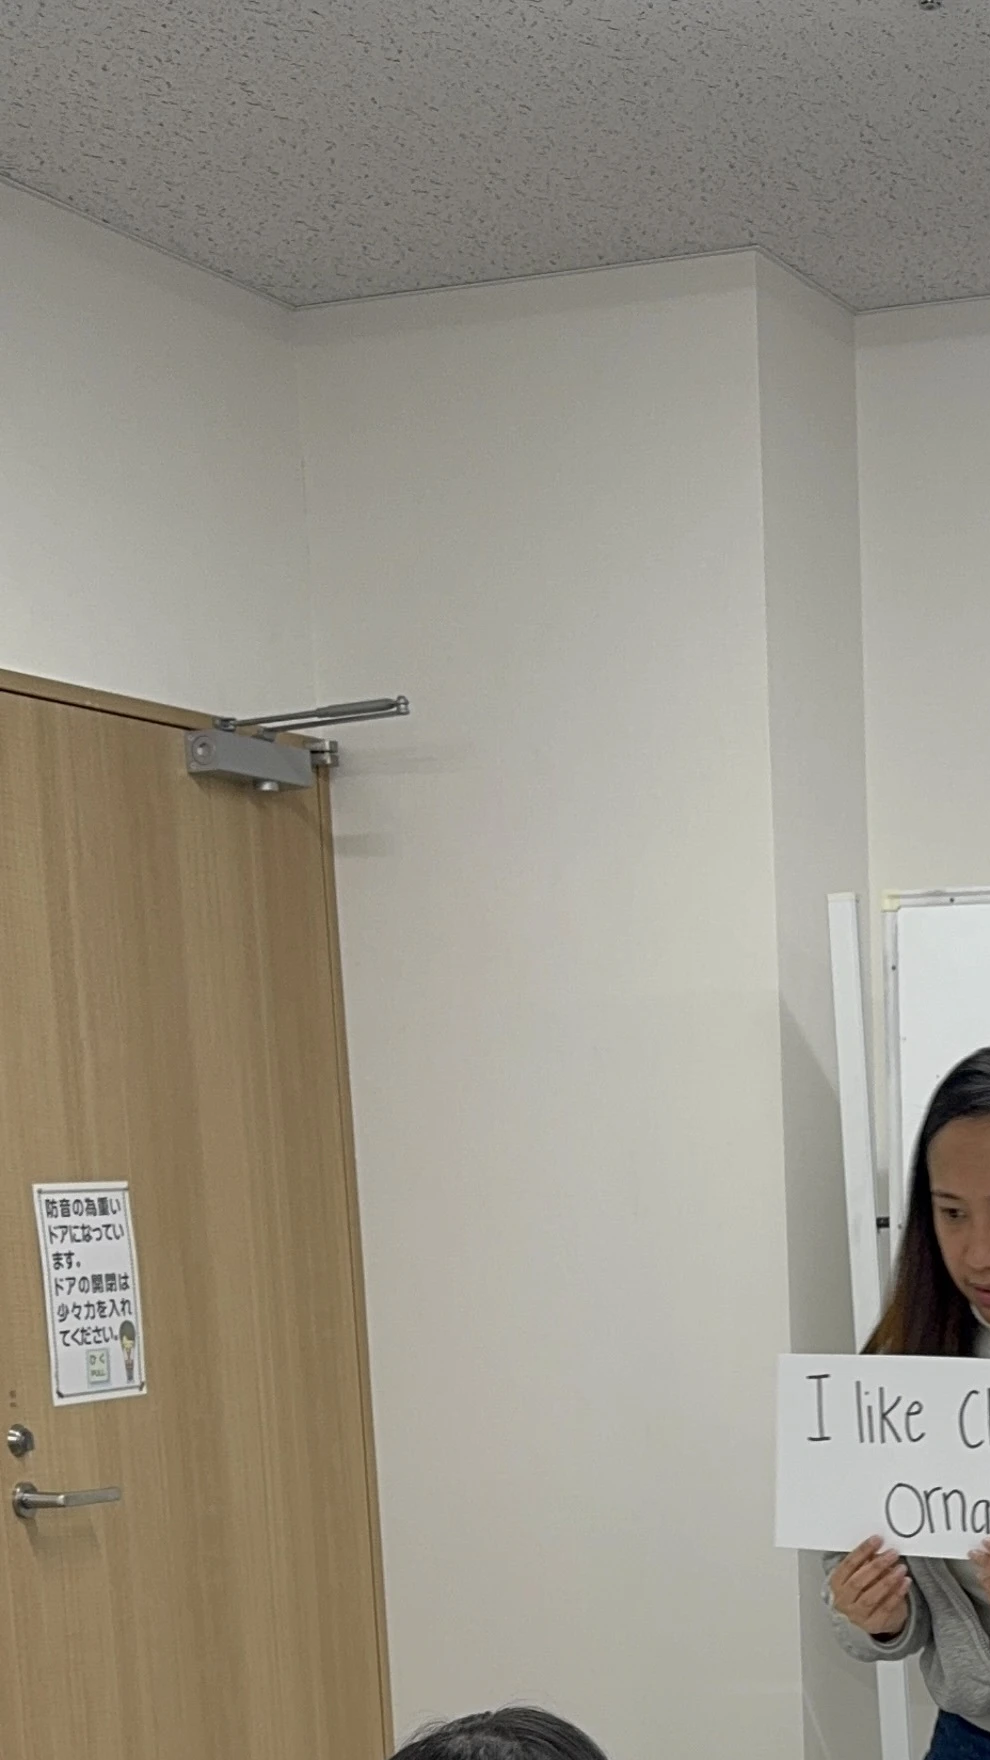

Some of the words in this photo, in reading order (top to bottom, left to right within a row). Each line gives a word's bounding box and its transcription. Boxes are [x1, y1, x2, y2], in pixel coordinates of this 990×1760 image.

[49, 1223, 124, 1244] ドアになってい
[52, 1252, 81, 1270] ます。
[54, 1272, 130, 1297] ドアの開閉は
[57, 1298, 133, 1322] 少々力を入れ
[60, 1328, 119, 1347] てください。
[806, 1373, 832, 1441] I
[855, 1381, 927, 1444] like
